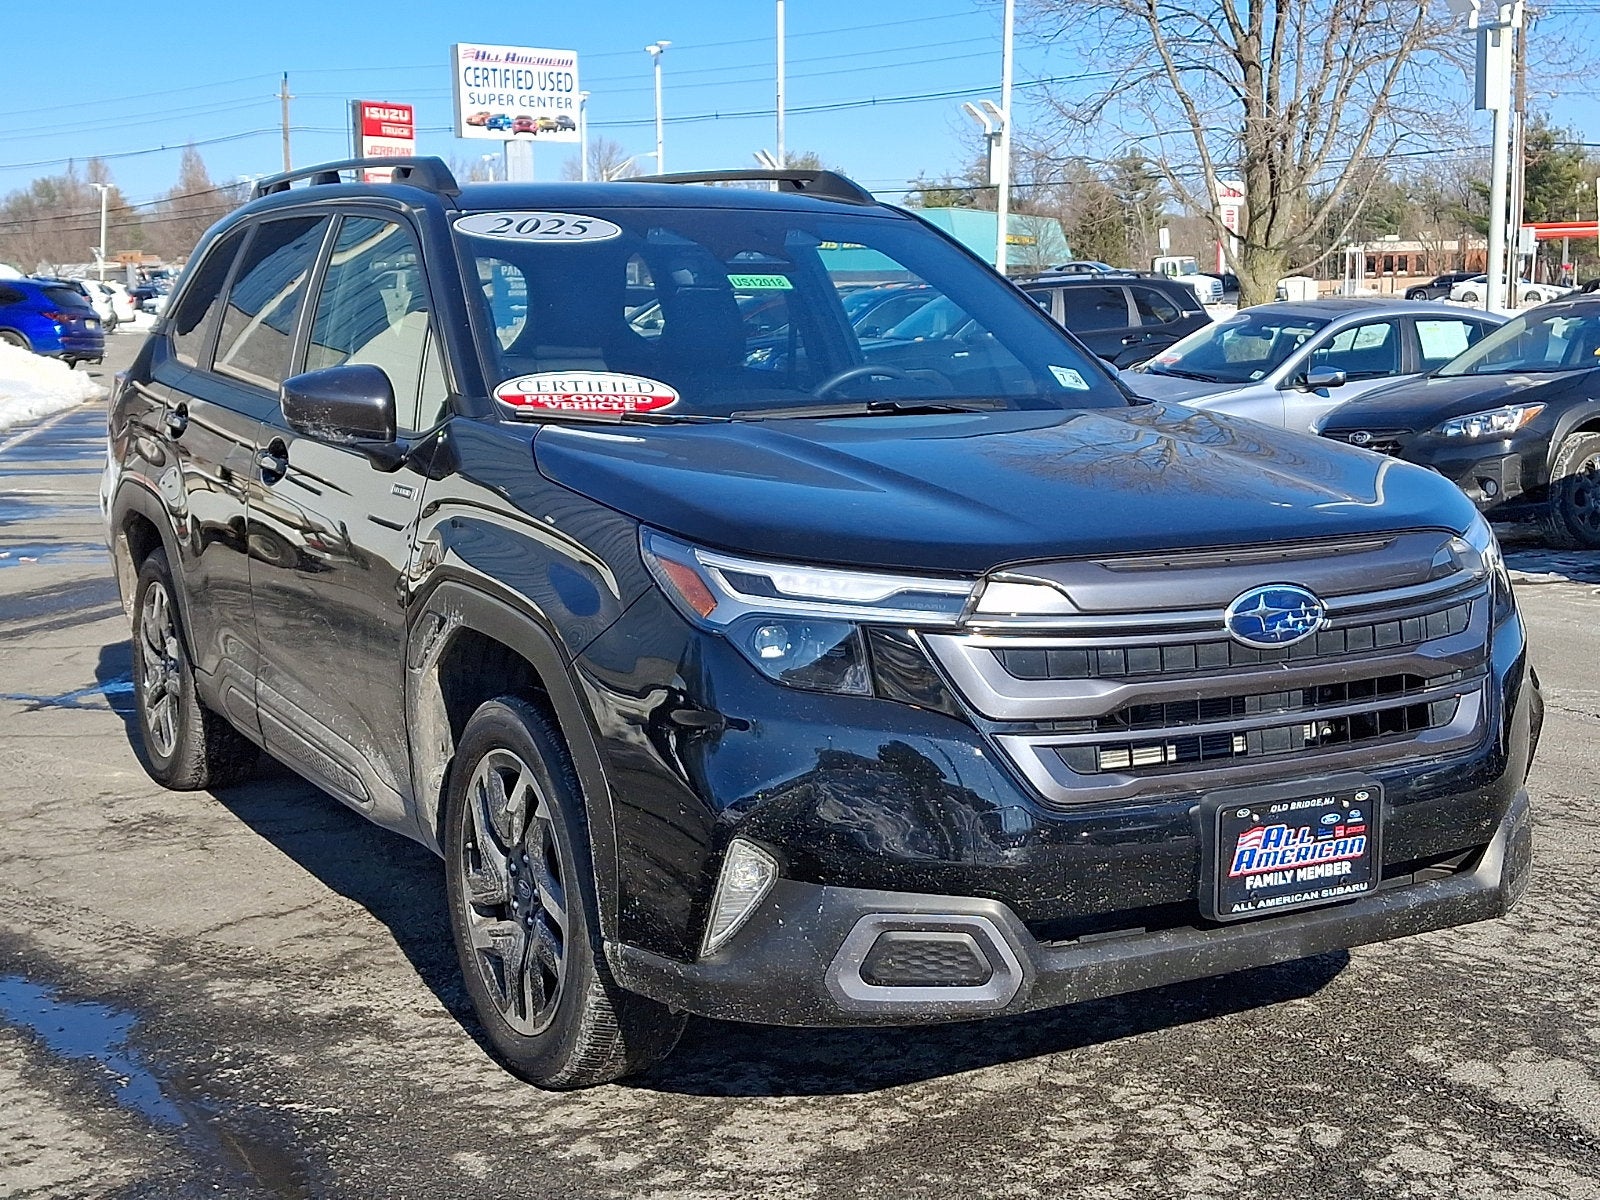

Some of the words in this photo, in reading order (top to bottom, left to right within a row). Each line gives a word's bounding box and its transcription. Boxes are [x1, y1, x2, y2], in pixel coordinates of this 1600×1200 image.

[464, 66, 534, 90] CERTIFIED
[537, 71, 574, 93] USED
[468, 92, 515, 106] SUPER
[519, 95, 573, 109] CENTER
[365, 106, 409, 121] ISUZU
[485, 217, 593, 236] 2025
[731, 277, 785, 288] US12018
[516, 379, 655, 394] CERTIFIED
[523, 393, 654, 404] PRE-OWNED
[545, 401, 637, 412] VEHICLE
[1270, 804, 1289, 813] OLD
[1262, 824, 1314, 850] ALL
[1231, 837, 1366, 875] AMERICAN
[1245, 869, 1295, 890] FAMILY
[1296, 860, 1352, 884] MEMBER
[1231, 902, 1256, 913] ALL
[1257, 892, 1320, 909] AMERICAN
[1321, 882, 1369, 897] SUBARU
